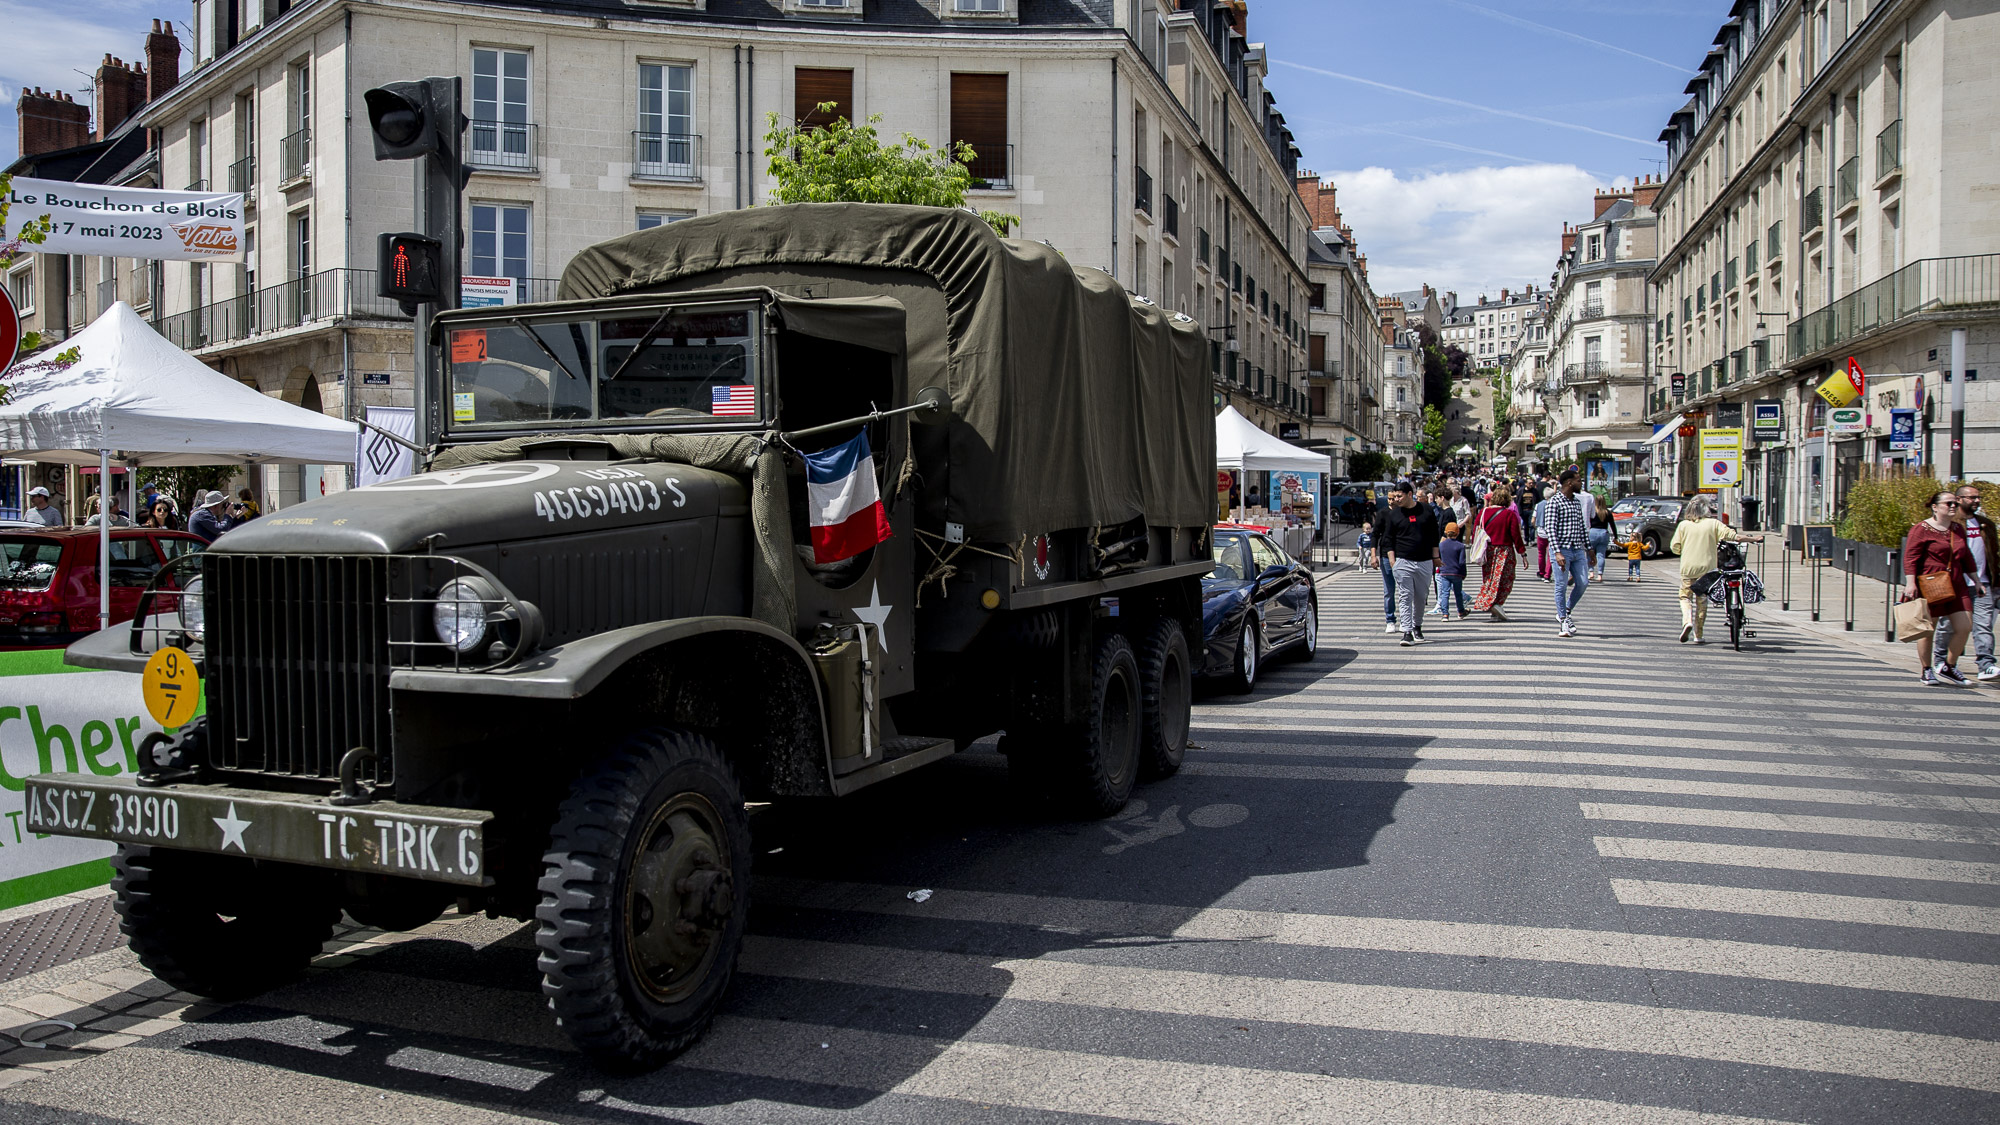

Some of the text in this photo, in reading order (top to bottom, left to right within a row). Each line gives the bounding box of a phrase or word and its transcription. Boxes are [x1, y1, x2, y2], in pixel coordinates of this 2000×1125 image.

[10, 190, 237, 219] Le Bouchon de Blois
[64, 222, 75, 234] 7
[81, 225, 115, 237] mai
[120, 225, 163, 240] 2023
[176, 223, 236, 247] Valve
[478, 339, 485, 359] 2
[1821, 387, 1844, 407] PRESSE
[576, 466, 645, 481] USA
[166, 653, 178, 678] 9
[165, 694, 176, 720] 7
[28, 786, 96, 832] ASCZ
[109, 793, 179, 840] 3990
[318, 814, 358, 861] TC
